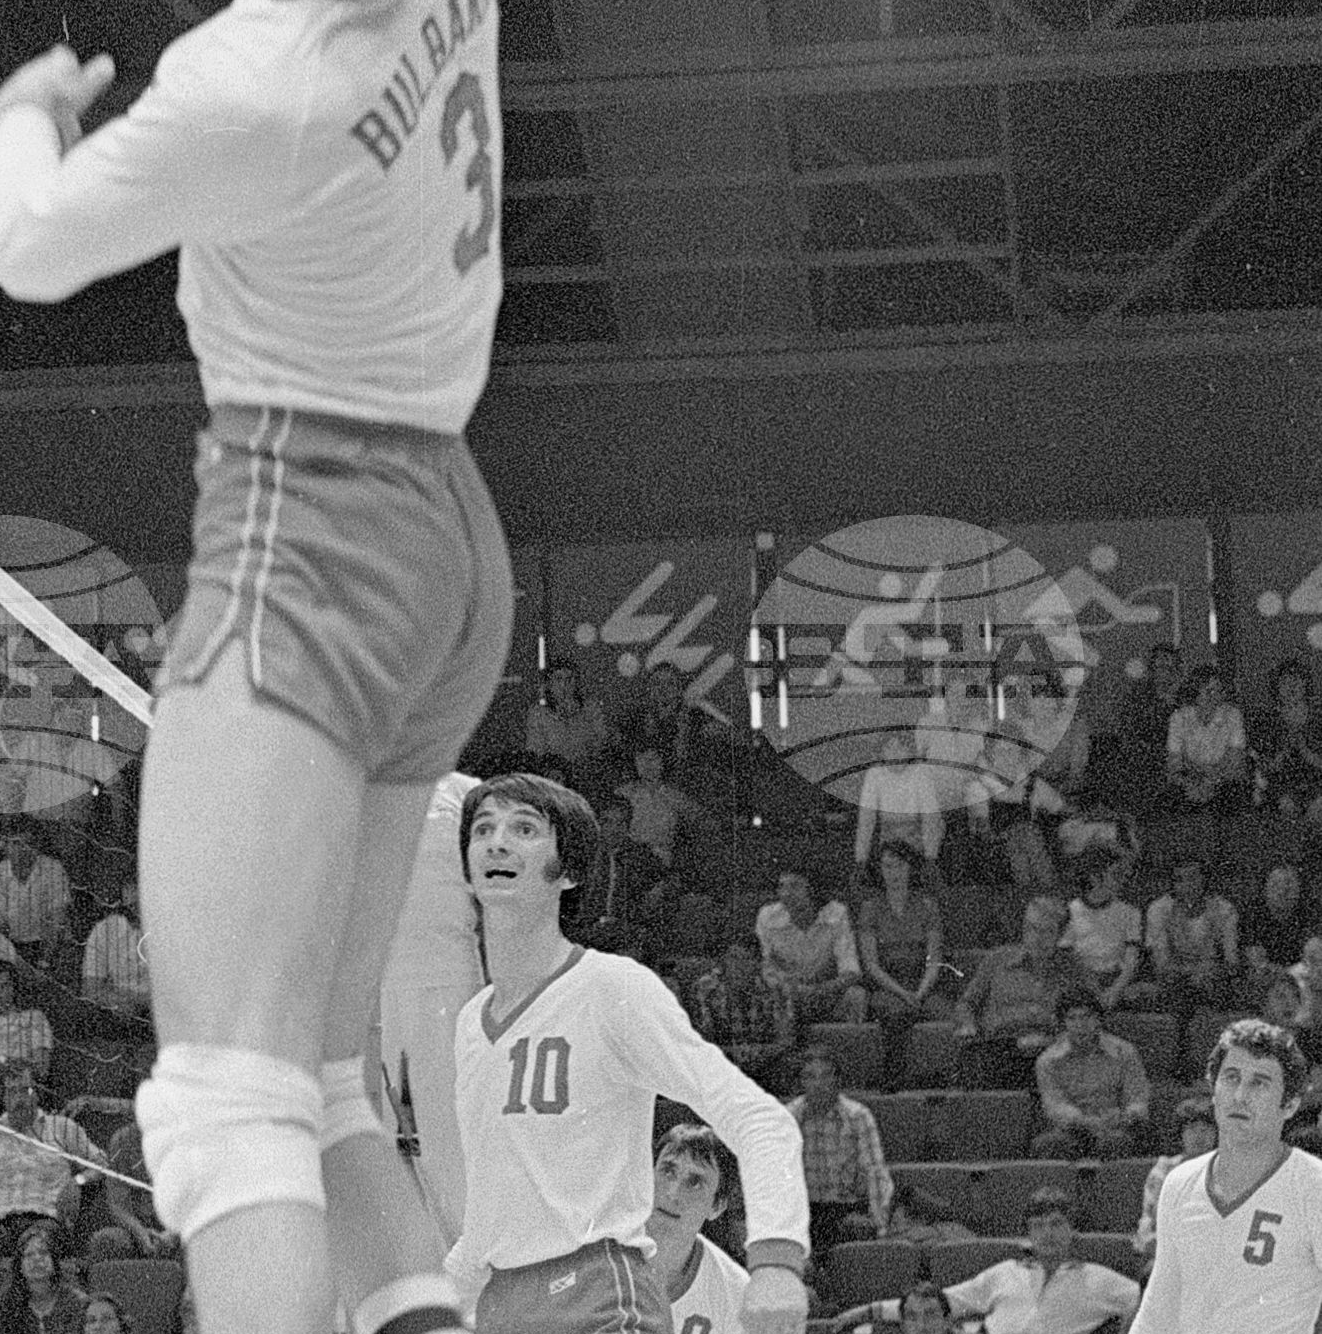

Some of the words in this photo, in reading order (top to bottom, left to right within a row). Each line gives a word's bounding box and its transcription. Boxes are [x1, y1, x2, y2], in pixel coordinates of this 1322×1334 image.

[440, 71, 495, 279] 3
[502, 1036, 571, 1115] 10
[1243, 1209, 1283, 1266] 5
